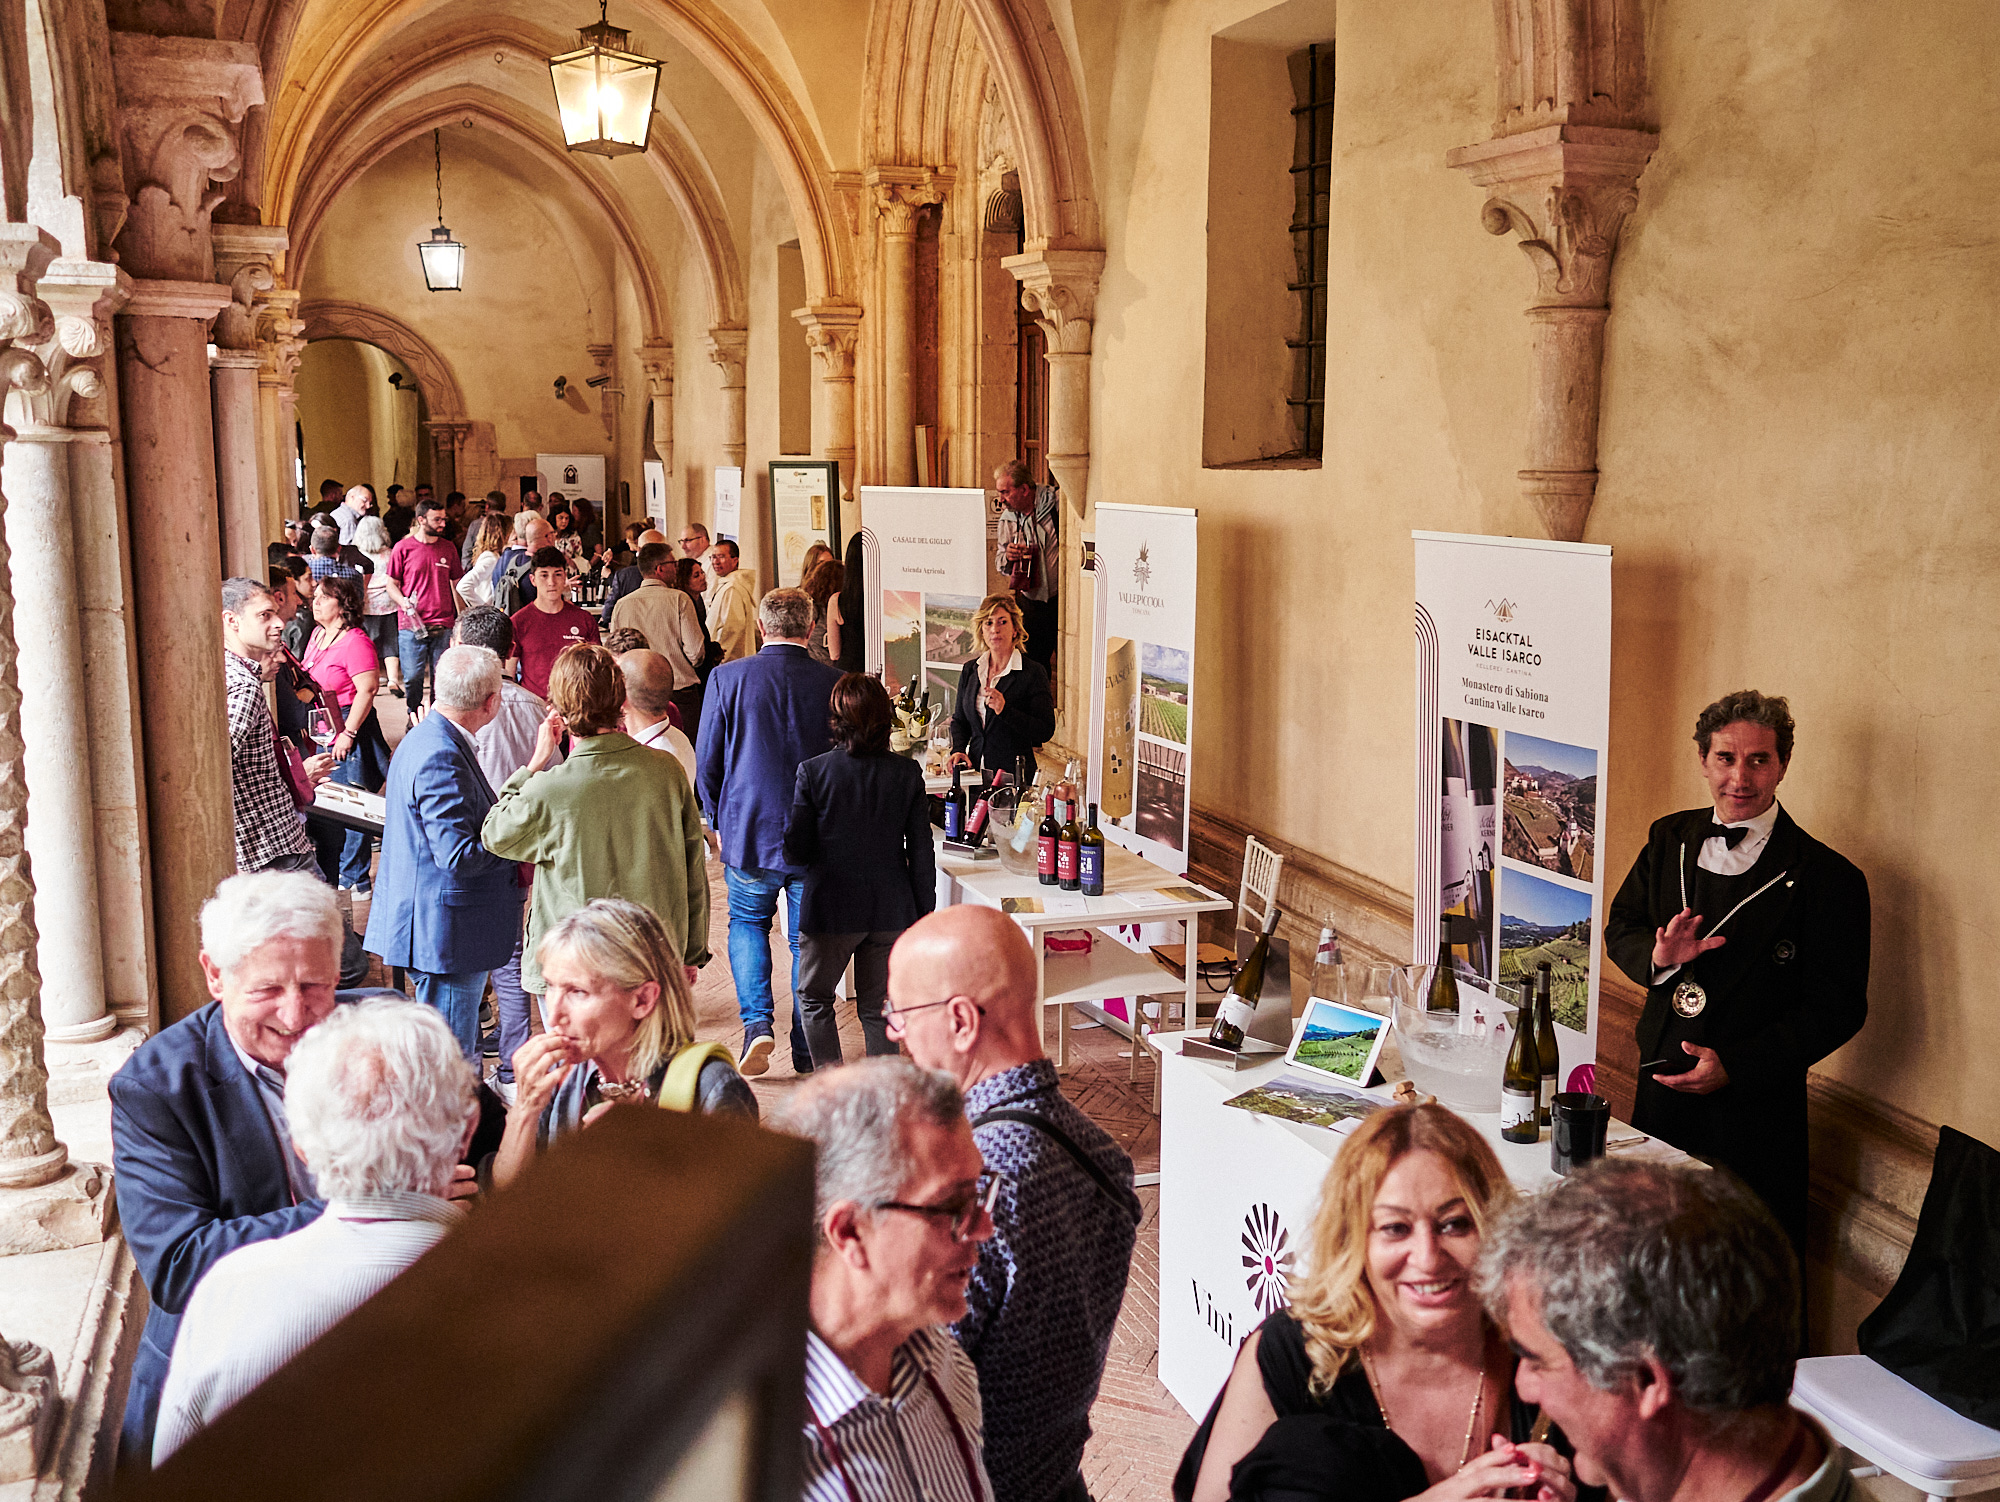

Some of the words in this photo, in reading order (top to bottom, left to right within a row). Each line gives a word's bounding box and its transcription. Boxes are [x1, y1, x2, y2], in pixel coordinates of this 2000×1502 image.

[892, 536, 917, 544] CASALE
[918, 537, 928, 545] DEL
[902, 565, 922, 574] Azienda
[923, 567, 946, 576] Agricola
[1475, 628, 1533, 648] EISACKTAL
[1467, 643, 1498, 660] VALLE
[1502, 649, 1542, 666] ISARCO
[1506, 667, 1533, 677] CANTINA
[1461, 677, 1503, 694] Monastero
[1504, 684, 1513, 697] di
[1515, 687, 1549, 703] Sabiona
[1464, 694, 1495, 710] Cantina
[1497, 699, 1517, 714] Valle
[1518, 704, 1545, 720] Isarco
[1191, 1277, 1233, 1349] Vini
